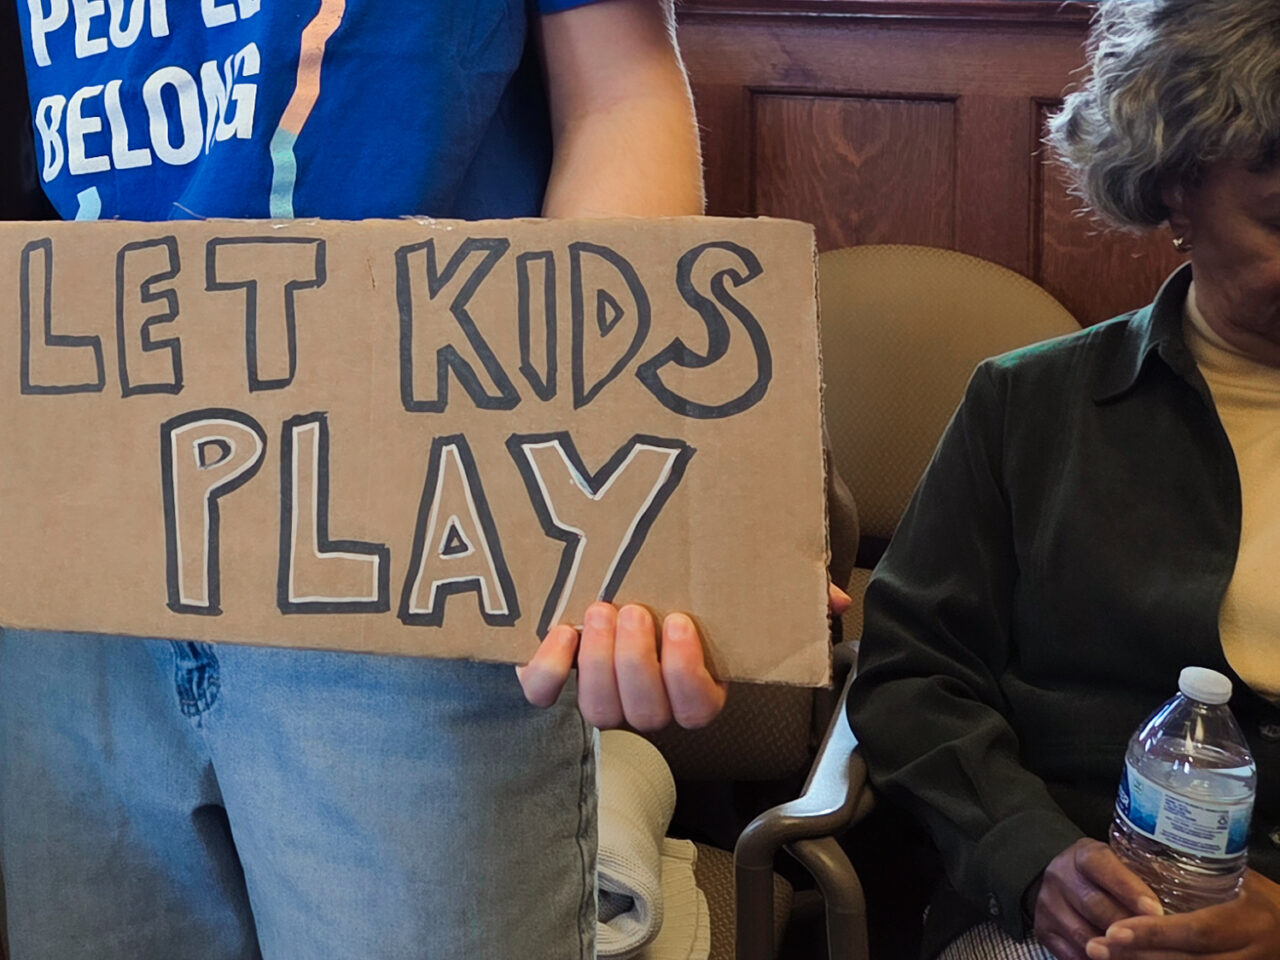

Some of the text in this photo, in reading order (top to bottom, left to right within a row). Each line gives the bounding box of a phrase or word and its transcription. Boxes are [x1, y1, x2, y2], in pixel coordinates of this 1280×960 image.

[35, 42, 261, 182] BELONG
[20, 235, 773, 419] LET KIDS
[160, 407, 696, 640] PLAY
